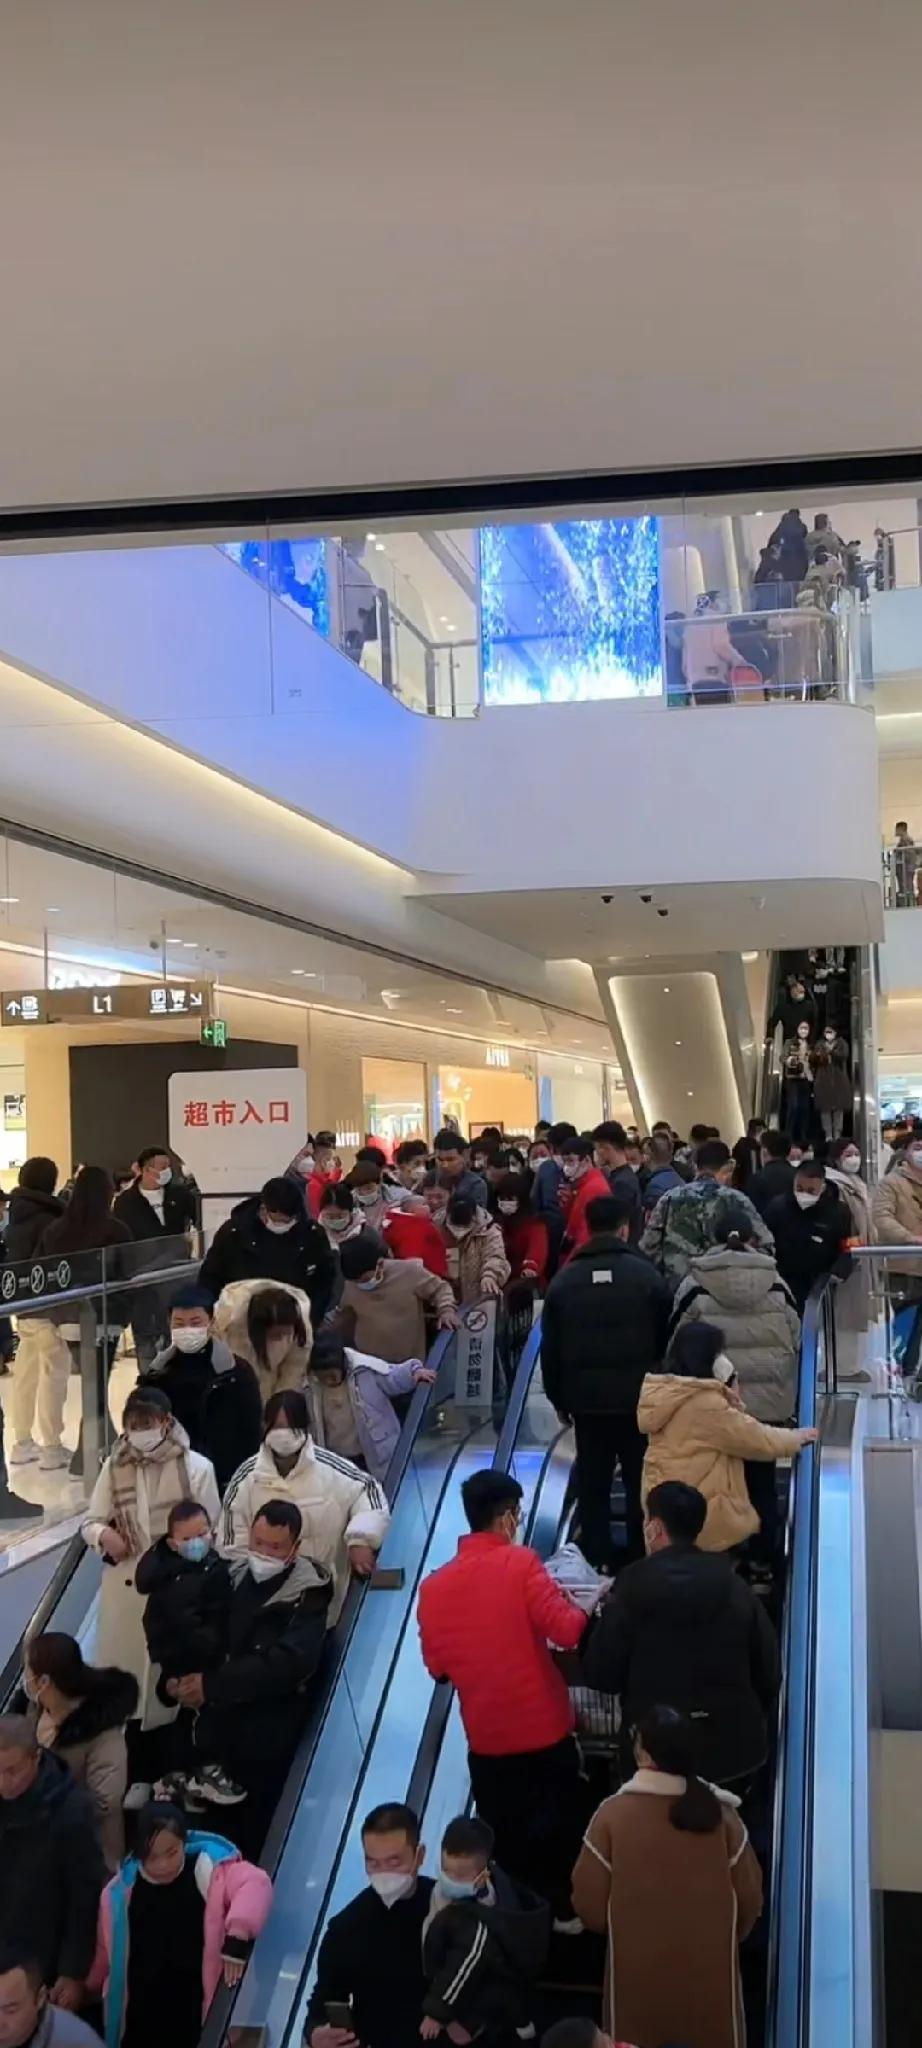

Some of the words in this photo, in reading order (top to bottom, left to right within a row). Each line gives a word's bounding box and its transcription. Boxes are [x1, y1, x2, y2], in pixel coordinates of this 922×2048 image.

[93, 995, 112, 1014] L1
[184, 1100, 290, 1127] 超市入口
